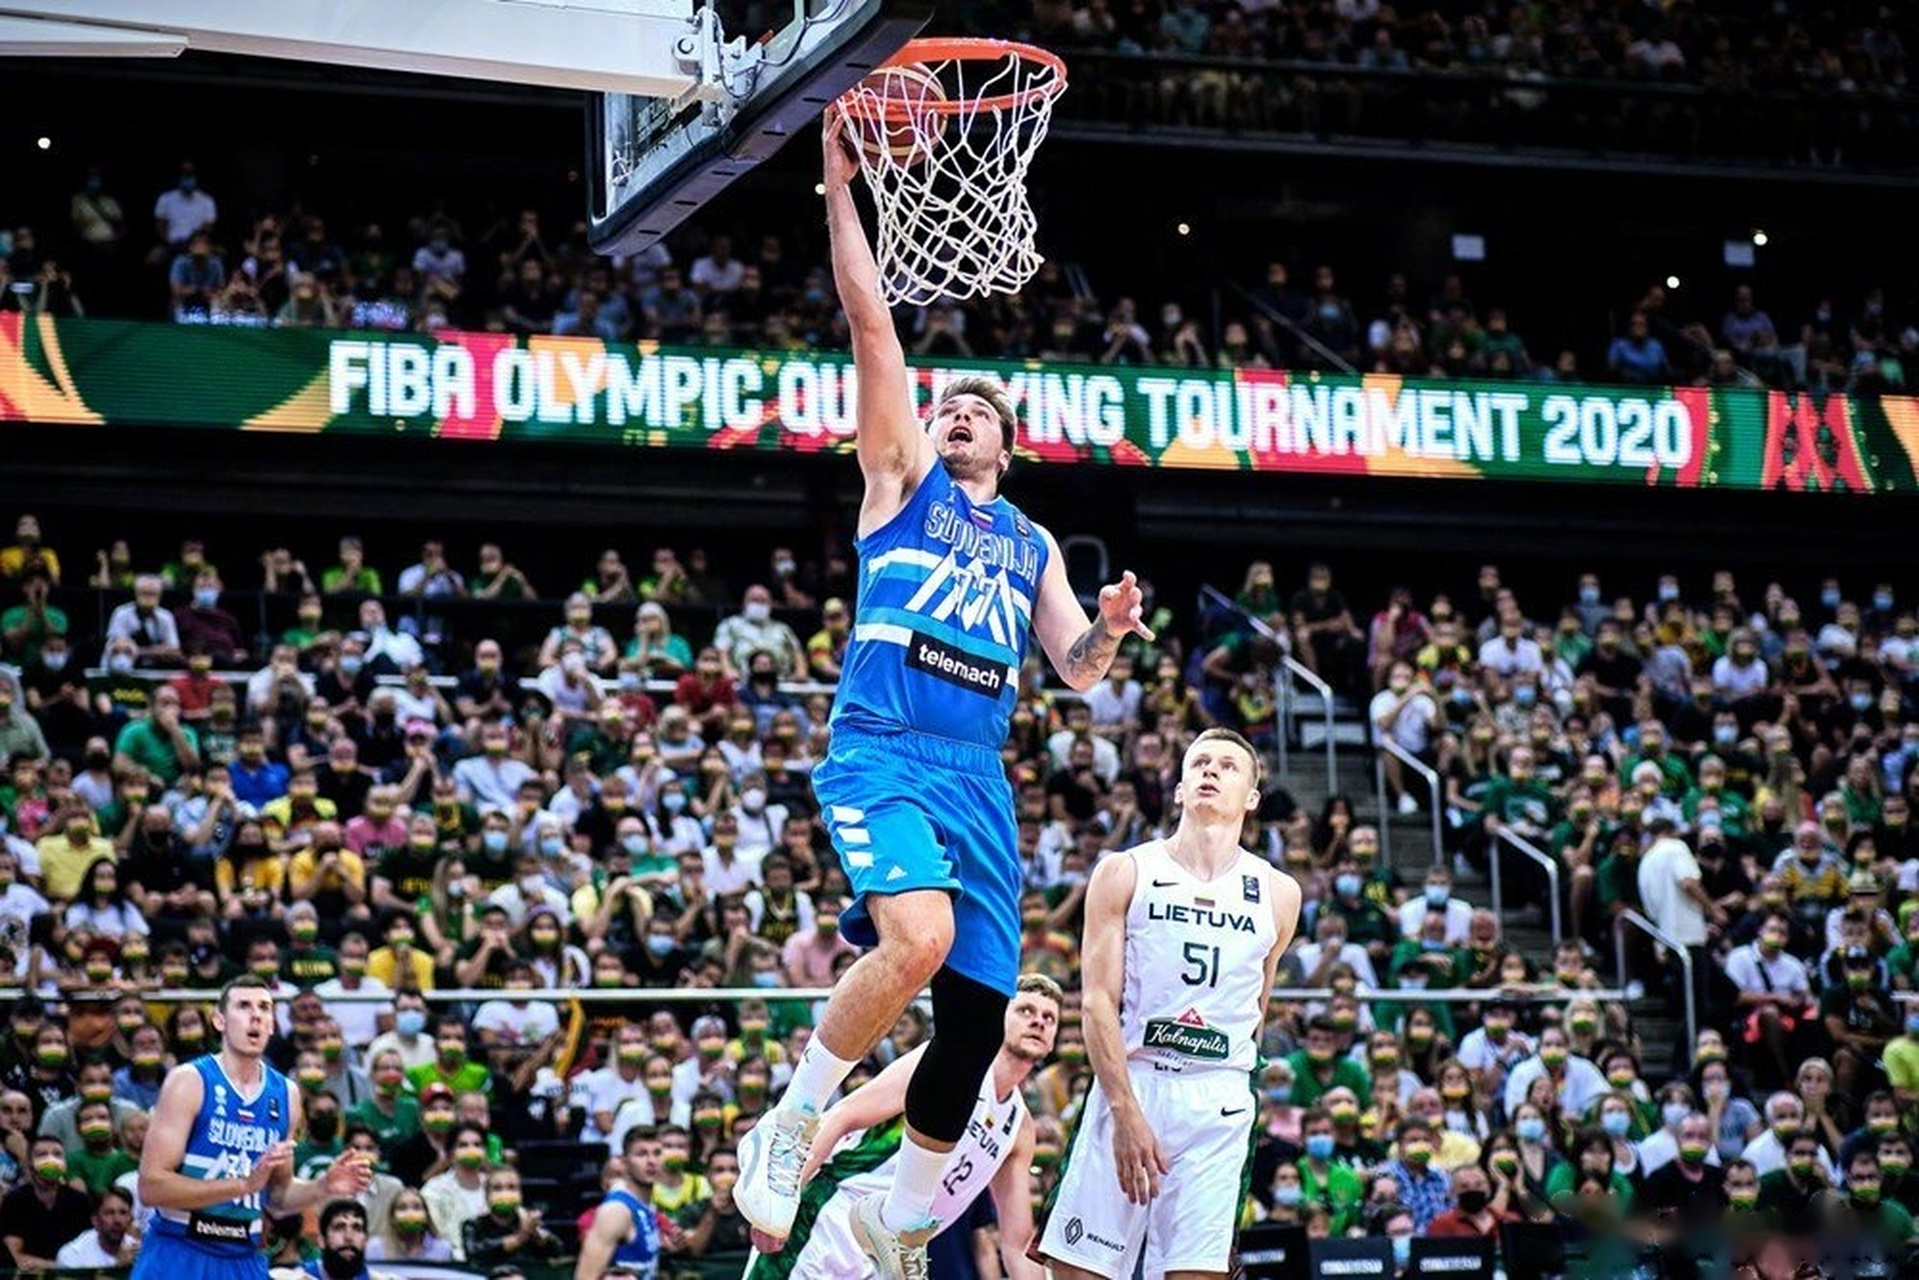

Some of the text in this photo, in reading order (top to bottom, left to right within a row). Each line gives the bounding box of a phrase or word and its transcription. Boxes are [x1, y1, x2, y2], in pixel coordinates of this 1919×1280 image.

[329, 339, 1693, 468] FIBA OLYMPIC QUIING TOURNAMENT 2020
[924, 500, 1039, 587] SLOVENIJA
[919, 643, 1001, 689] telemach
[1148, 902, 1256, 935] LIETUVA
[1180, 941, 1220, 988] 51
[1147, 1023, 1228, 1054] Kalnapilis
